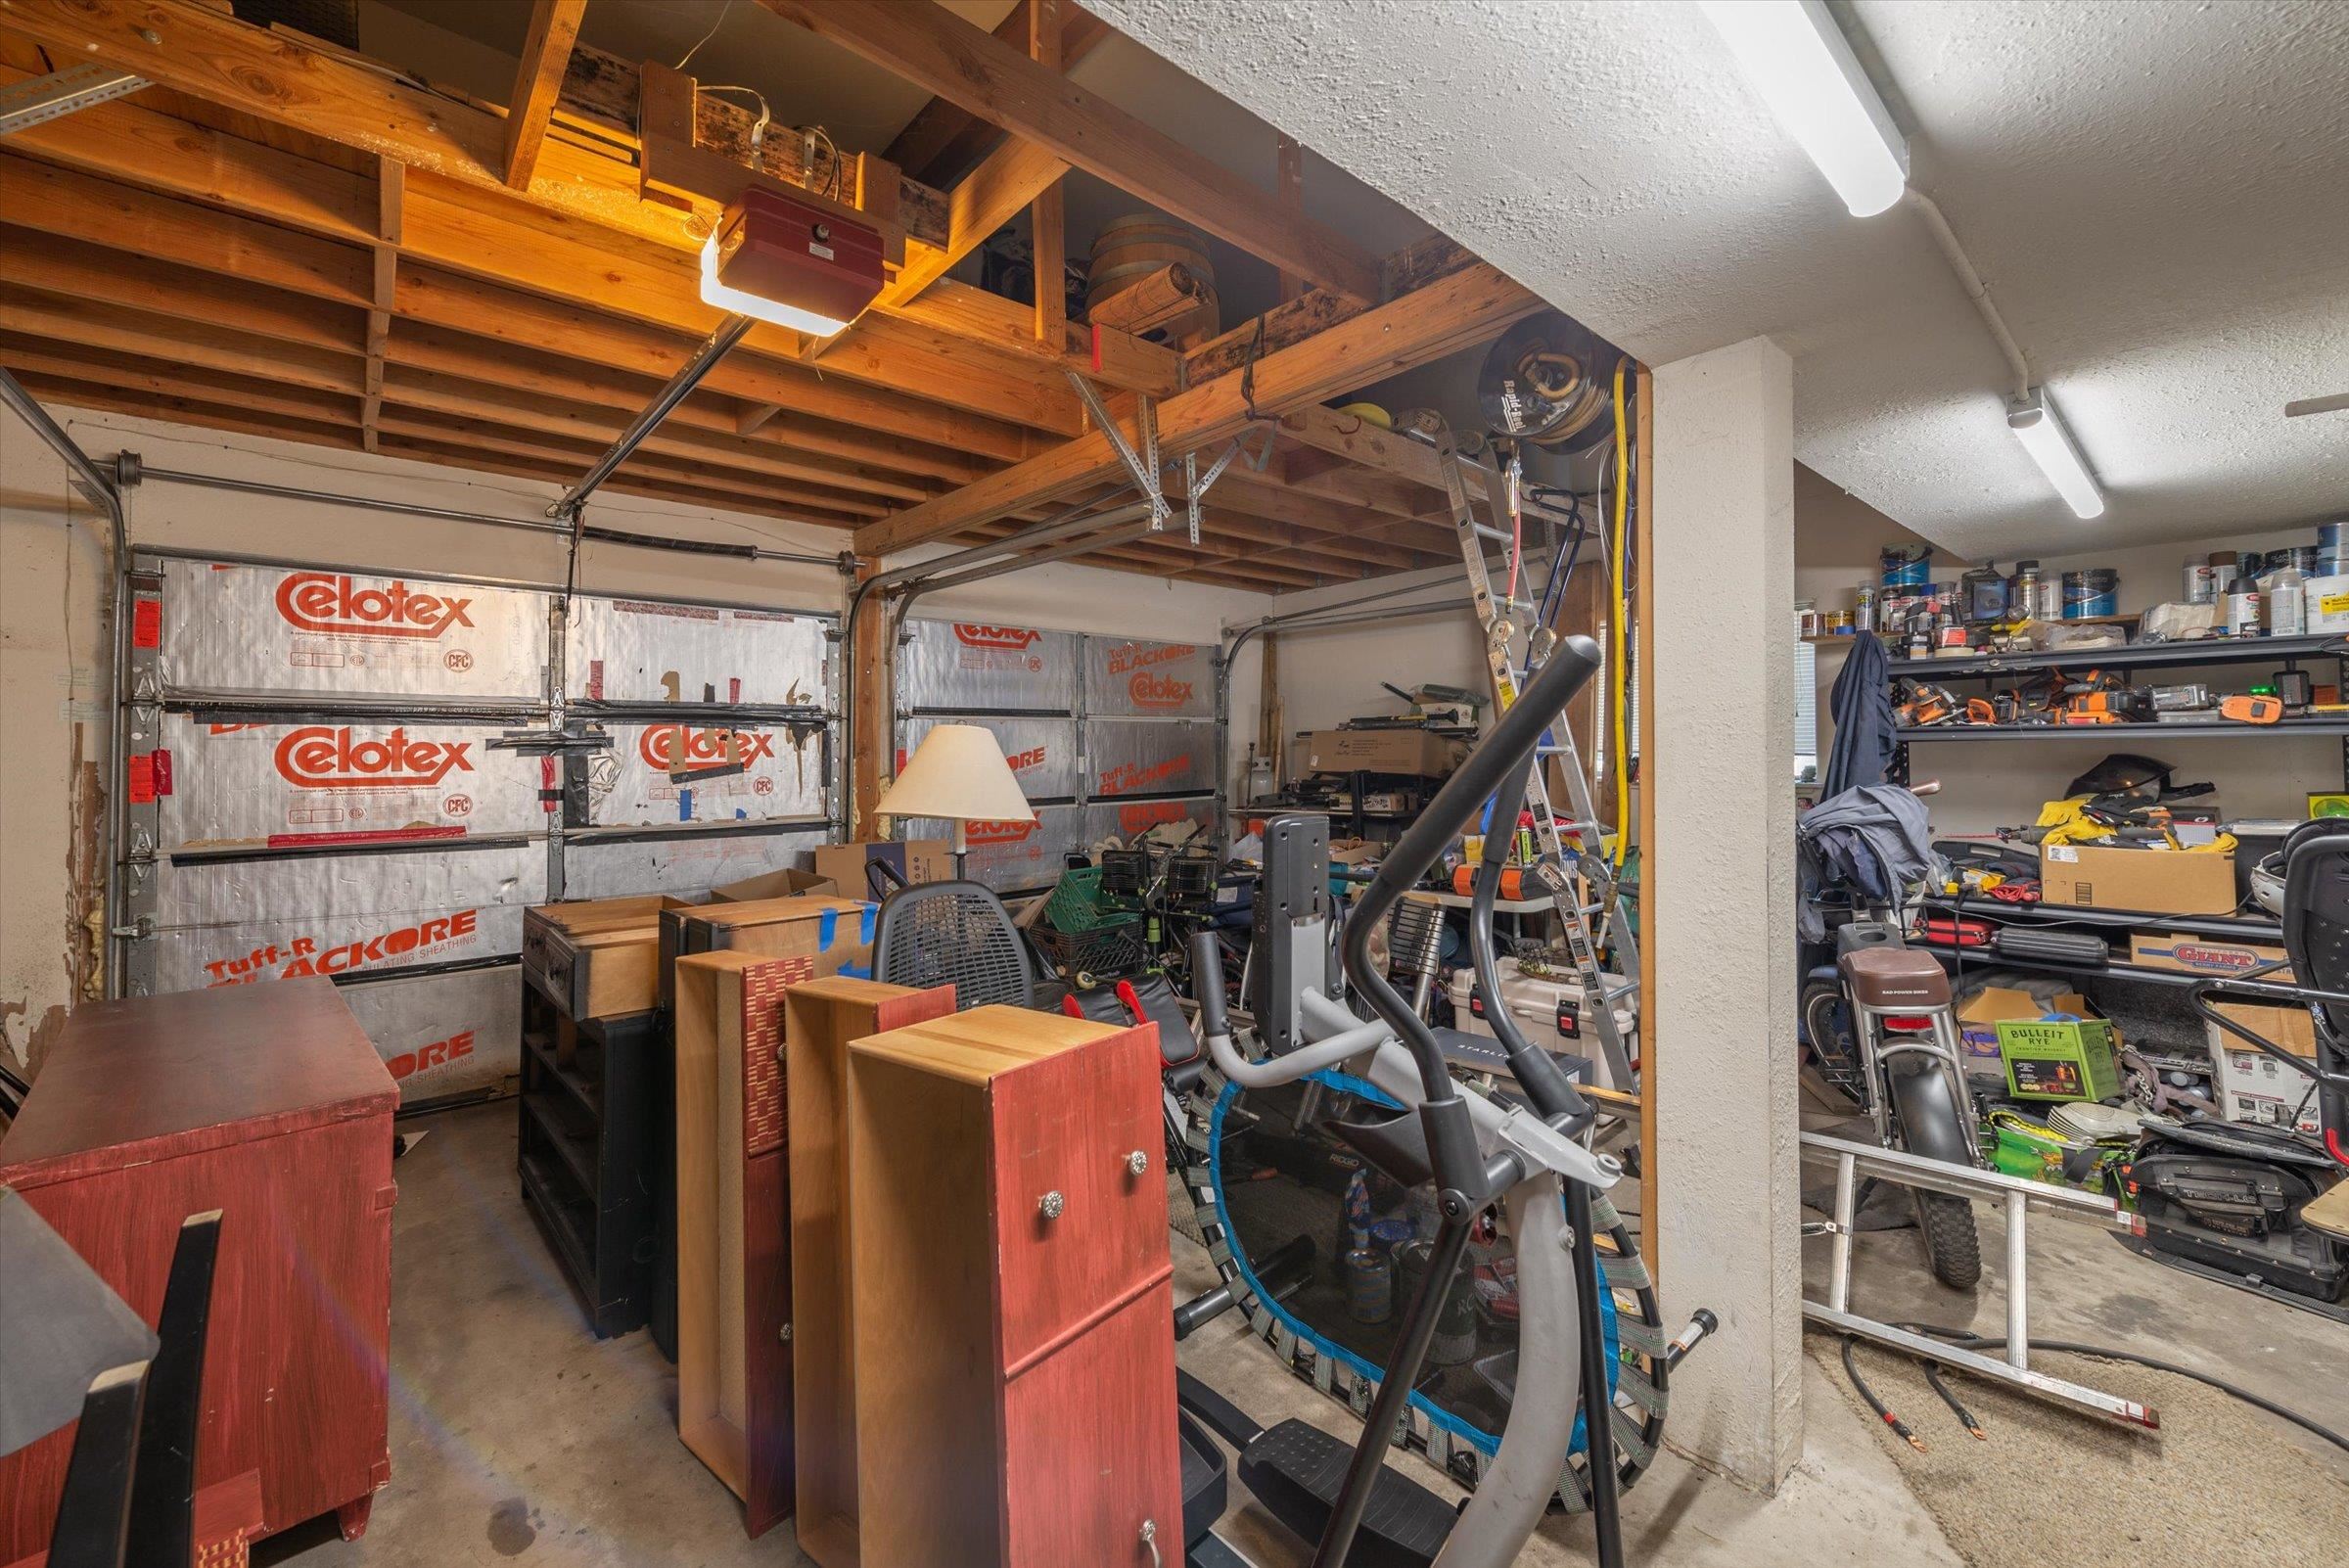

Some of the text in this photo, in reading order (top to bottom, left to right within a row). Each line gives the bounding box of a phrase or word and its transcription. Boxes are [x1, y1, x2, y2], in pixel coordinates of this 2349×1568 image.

[1503, 380, 1527, 430] Rapid-Reel
[275, 572, 476, 639] Celotex
[1108, 644, 1196, 675] BLACKORE
[1128, 671, 1193, 708] Celotex
[274, 726, 475, 787] Celotex
[205, 937, 318, 979] Tuff-R
[419, 934, 477, 959] SHEATHING
[2178, 946, 2252, 966] GIANT
[2010, 1029, 2065, 1039] BULLEIT
[417, 1055, 475, 1087] SHEATHING
